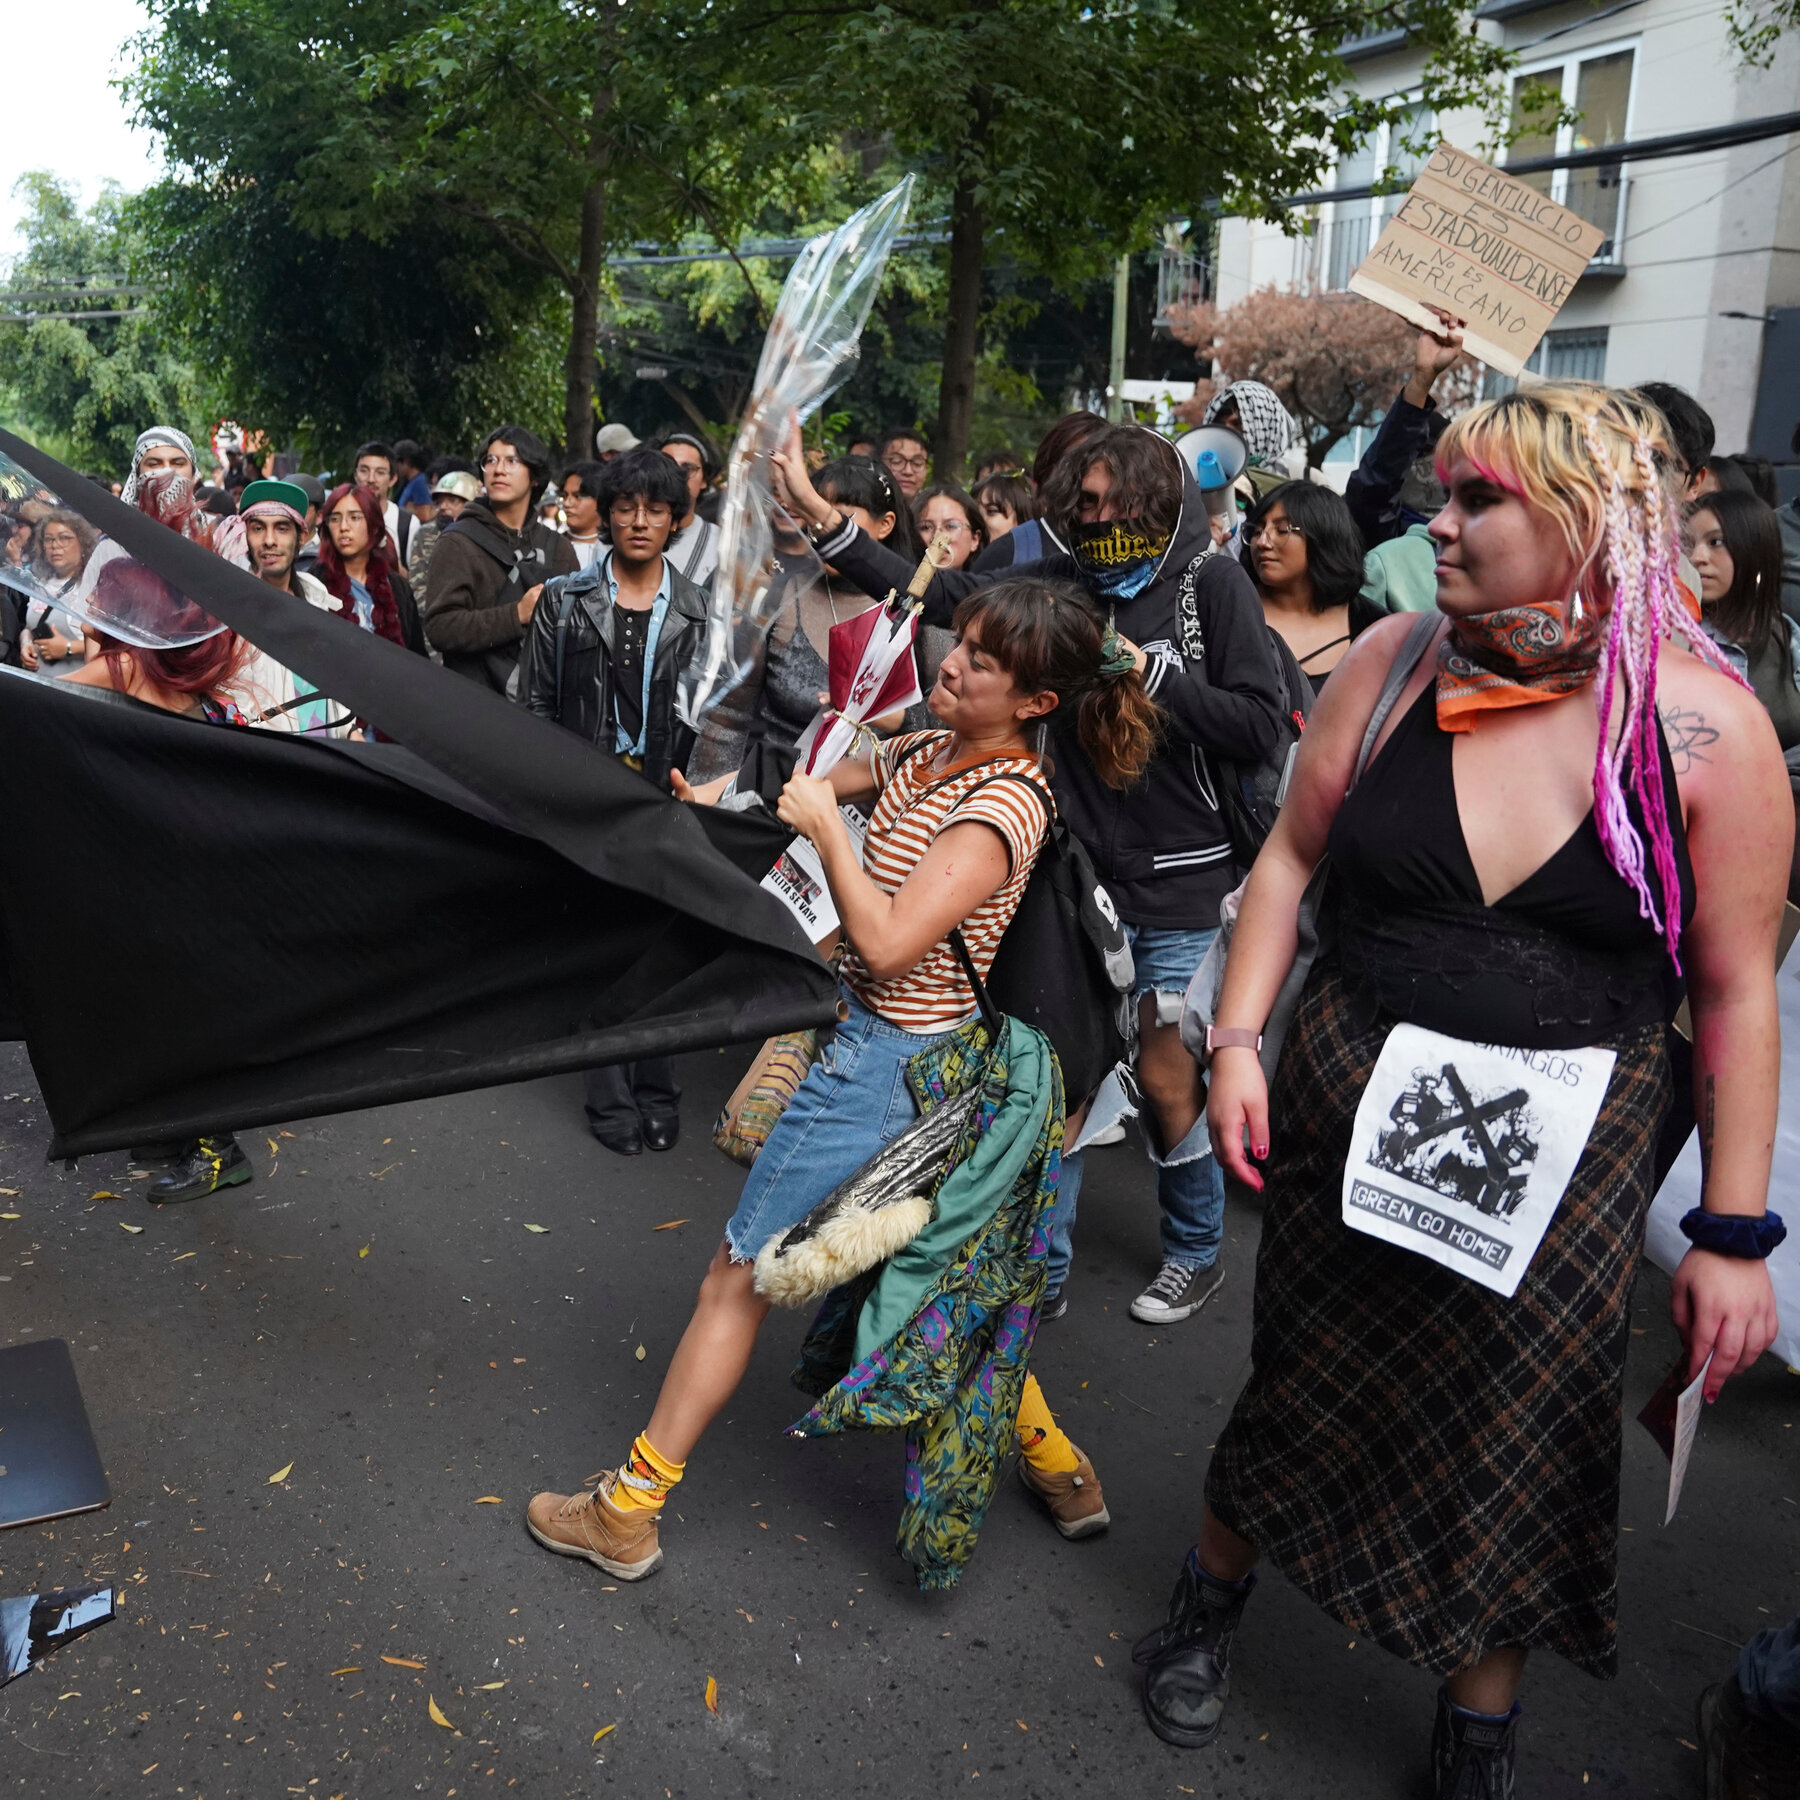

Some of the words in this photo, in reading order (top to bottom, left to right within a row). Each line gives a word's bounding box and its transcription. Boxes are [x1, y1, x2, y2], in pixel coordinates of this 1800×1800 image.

[1428, 148, 1466, 182] SU
[1460, 167, 1583, 244] GENTILICIO
[1463, 202, 1510, 233] ES
[1396, 194, 1575, 308] ESTADOUNIDENSE
[1462, 268, 1485, 283] ES
[1372, 240, 1526, 333] AMERICANO
[848, 808, 859, 822] LA
[789, 890, 801, 904] SE
[1351, 1184, 1414, 1222] ¡GREEN
[1416, 1212, 1446, 1234] GO
[1448, 1223, 1507, 1265] HOME!
